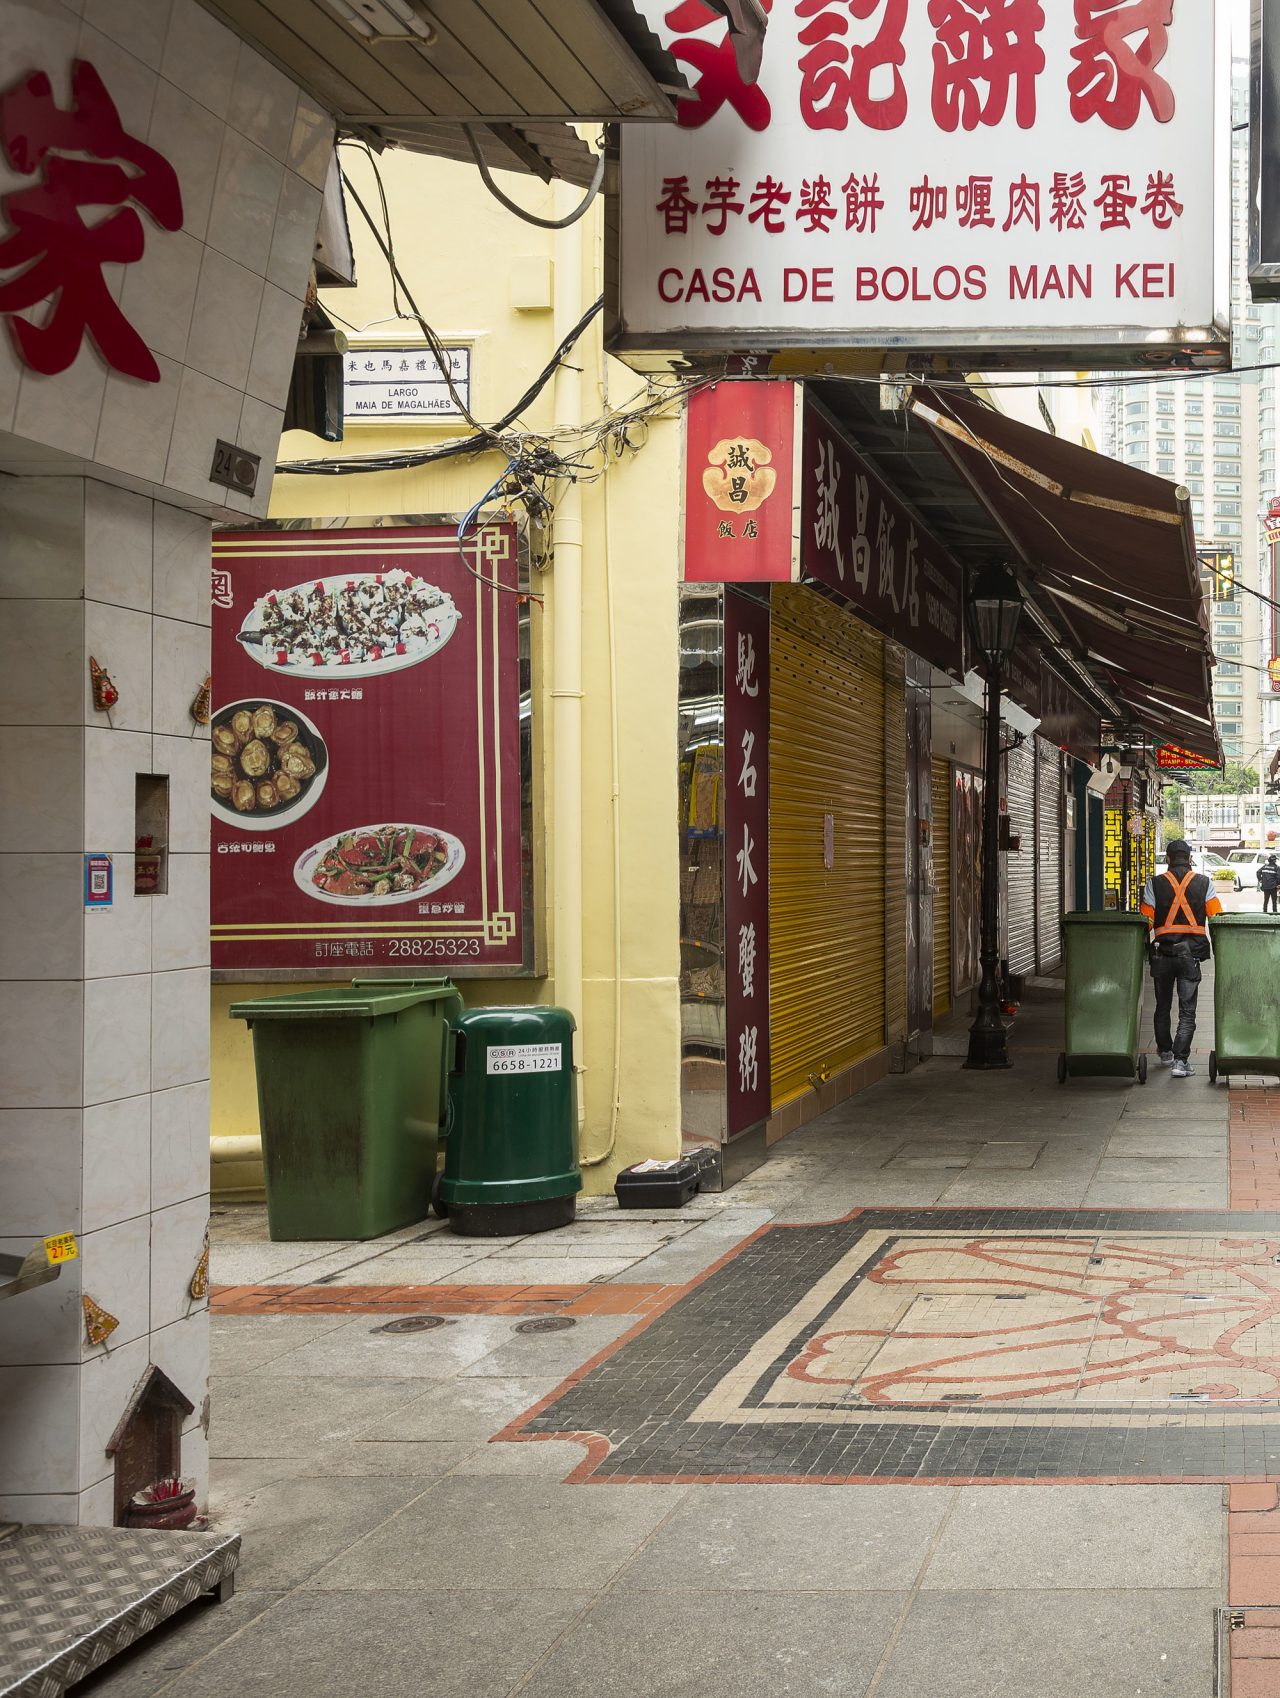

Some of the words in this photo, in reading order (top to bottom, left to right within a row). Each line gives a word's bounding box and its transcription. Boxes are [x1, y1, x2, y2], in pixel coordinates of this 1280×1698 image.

[656, 173, 884, 236] 香芋老婆餅
[658, 267, 762, 303] CASA
[784, 267, 833, 301] DE
[857, 264, 987, 302] BOLOS
[1009, 263, 1091, 299] MAN
[1115, 262, 1174, 297] KEI
[355, 401, 377, 410] MAIA
[381, 401, 392, 409] DE
[397, 398, 451, 410] MAGALHÃES
[388, 388, 418, 397] LARGO
[215, 448, 232, 475] 24
[727, 447, 754, 504] 誠昌
[718, 520, 759, 539] 飯店
[813, 437, 920, 627] 誠昌飯店
[736, 632, 759, 1094] 馳名水蟹粥
[315, 941, 374, 957] 訂座電話
[493, 1057, 559, 1071] 6658-1221
